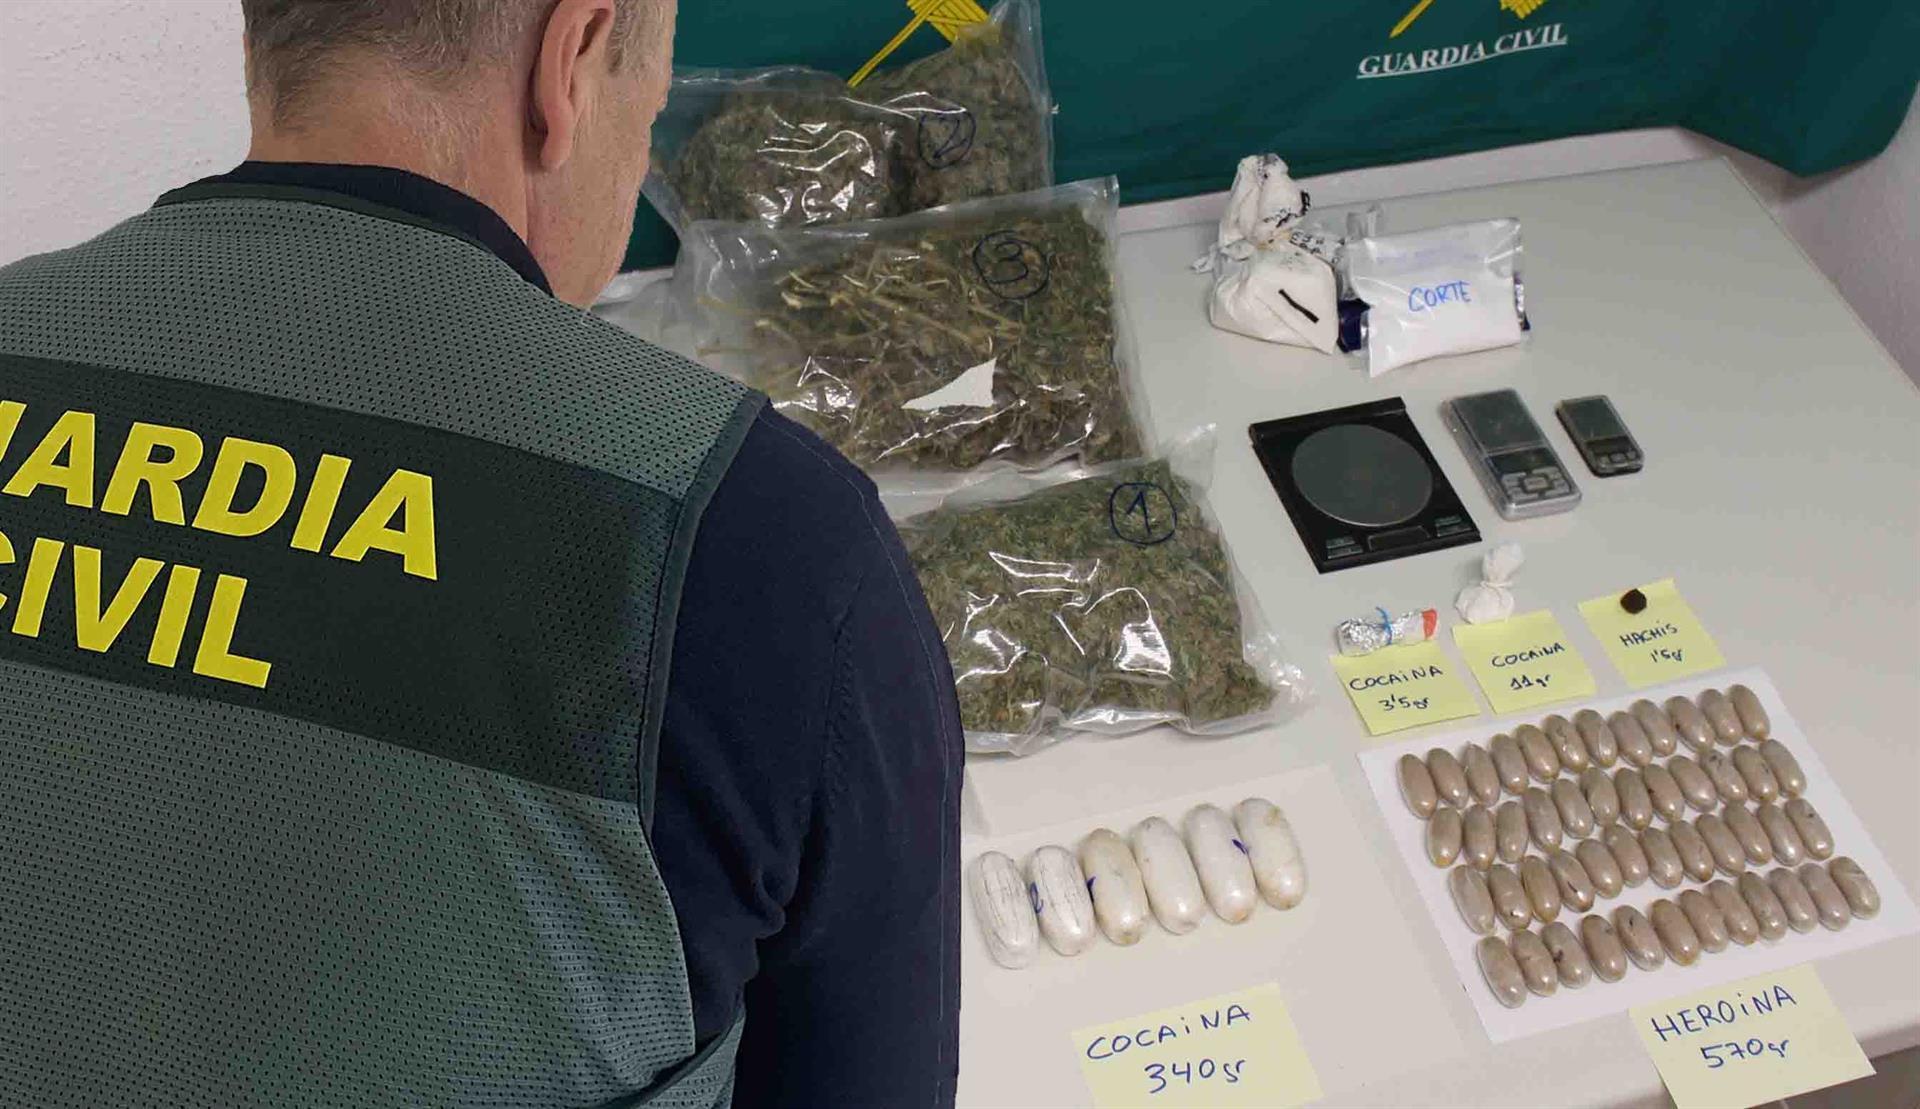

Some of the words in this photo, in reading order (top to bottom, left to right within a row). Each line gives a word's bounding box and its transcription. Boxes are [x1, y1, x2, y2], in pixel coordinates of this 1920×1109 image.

[1358, 41, 1486, 76] GUARDIA
[1494, 22, 1568, 54] CIVIL
[993, 240, 1029, 285] 3
[1408, 280, 1472, 312] CORTE
[0, 400, 439, 582] ARDIA
[1126, 489, 1152, 534] 1
